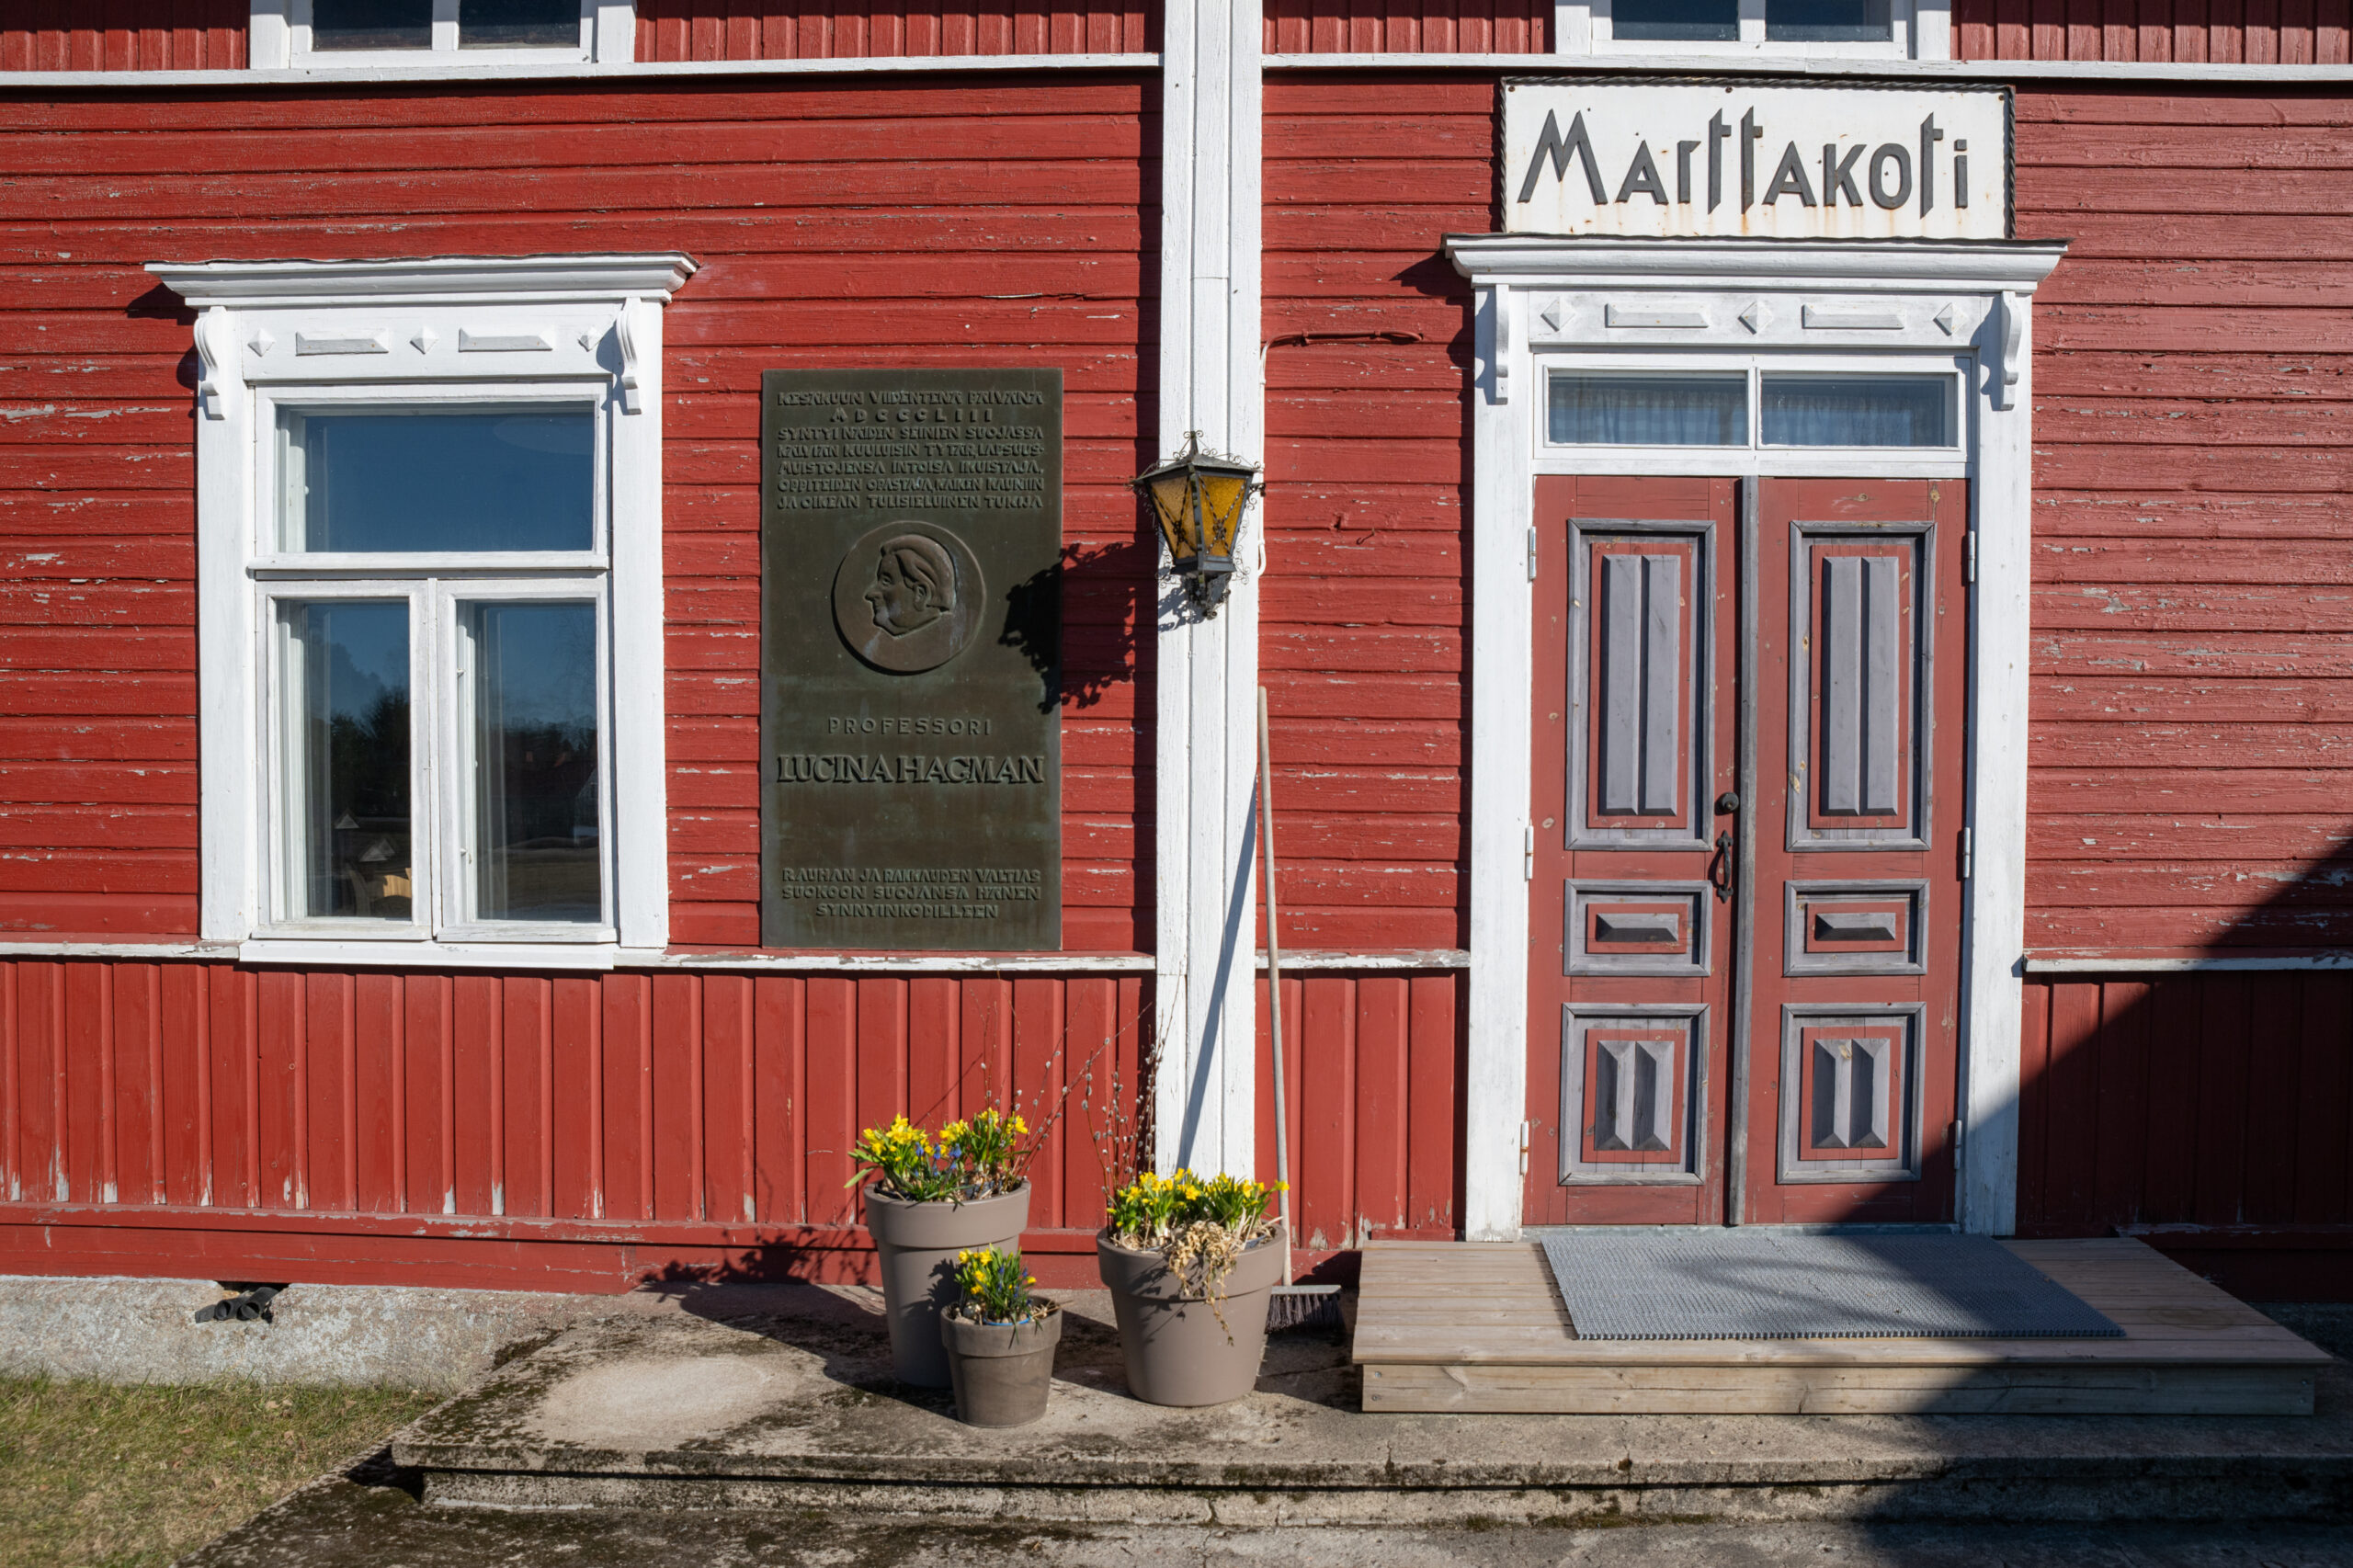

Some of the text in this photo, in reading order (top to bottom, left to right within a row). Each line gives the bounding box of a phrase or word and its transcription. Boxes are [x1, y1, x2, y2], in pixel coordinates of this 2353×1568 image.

[870, 390, 962, 405] VIIDENTENÄ
[968, 390, 1043, 405] PÄIVÄNÄ
[779, 426, 1043, 440] SYNTYI NÄIDEN SEINIEN SUOJASSA
[843, 443, 919, 457] KUULUISIN
[778, 460, 886, 475] MUISTOJENSA
[891, 460, 953, 474] INTOISA
[778, 477, 862, 493] OPPITEIDEN
[934, 477, 983, 492] KAIKEN
[985, 477, 1044, 492] KAUNIIN
[777, 494, 1043, 509] JA OIKEAN TULISIELUINEN TUKIJA
[827, 717, 992, 736] PROFESSORI
[777, 754, 1045, 784] LUCINA HAGMAN
[782, 868, 1041, 883] RAUHAN JA RAKKAUDEN VALTIAS
[782, 885, 1041, 901] SUOKOON SUOJANSA HÄNEN
[815, 903, 999, 919] SYNNYINKODILLEEN
